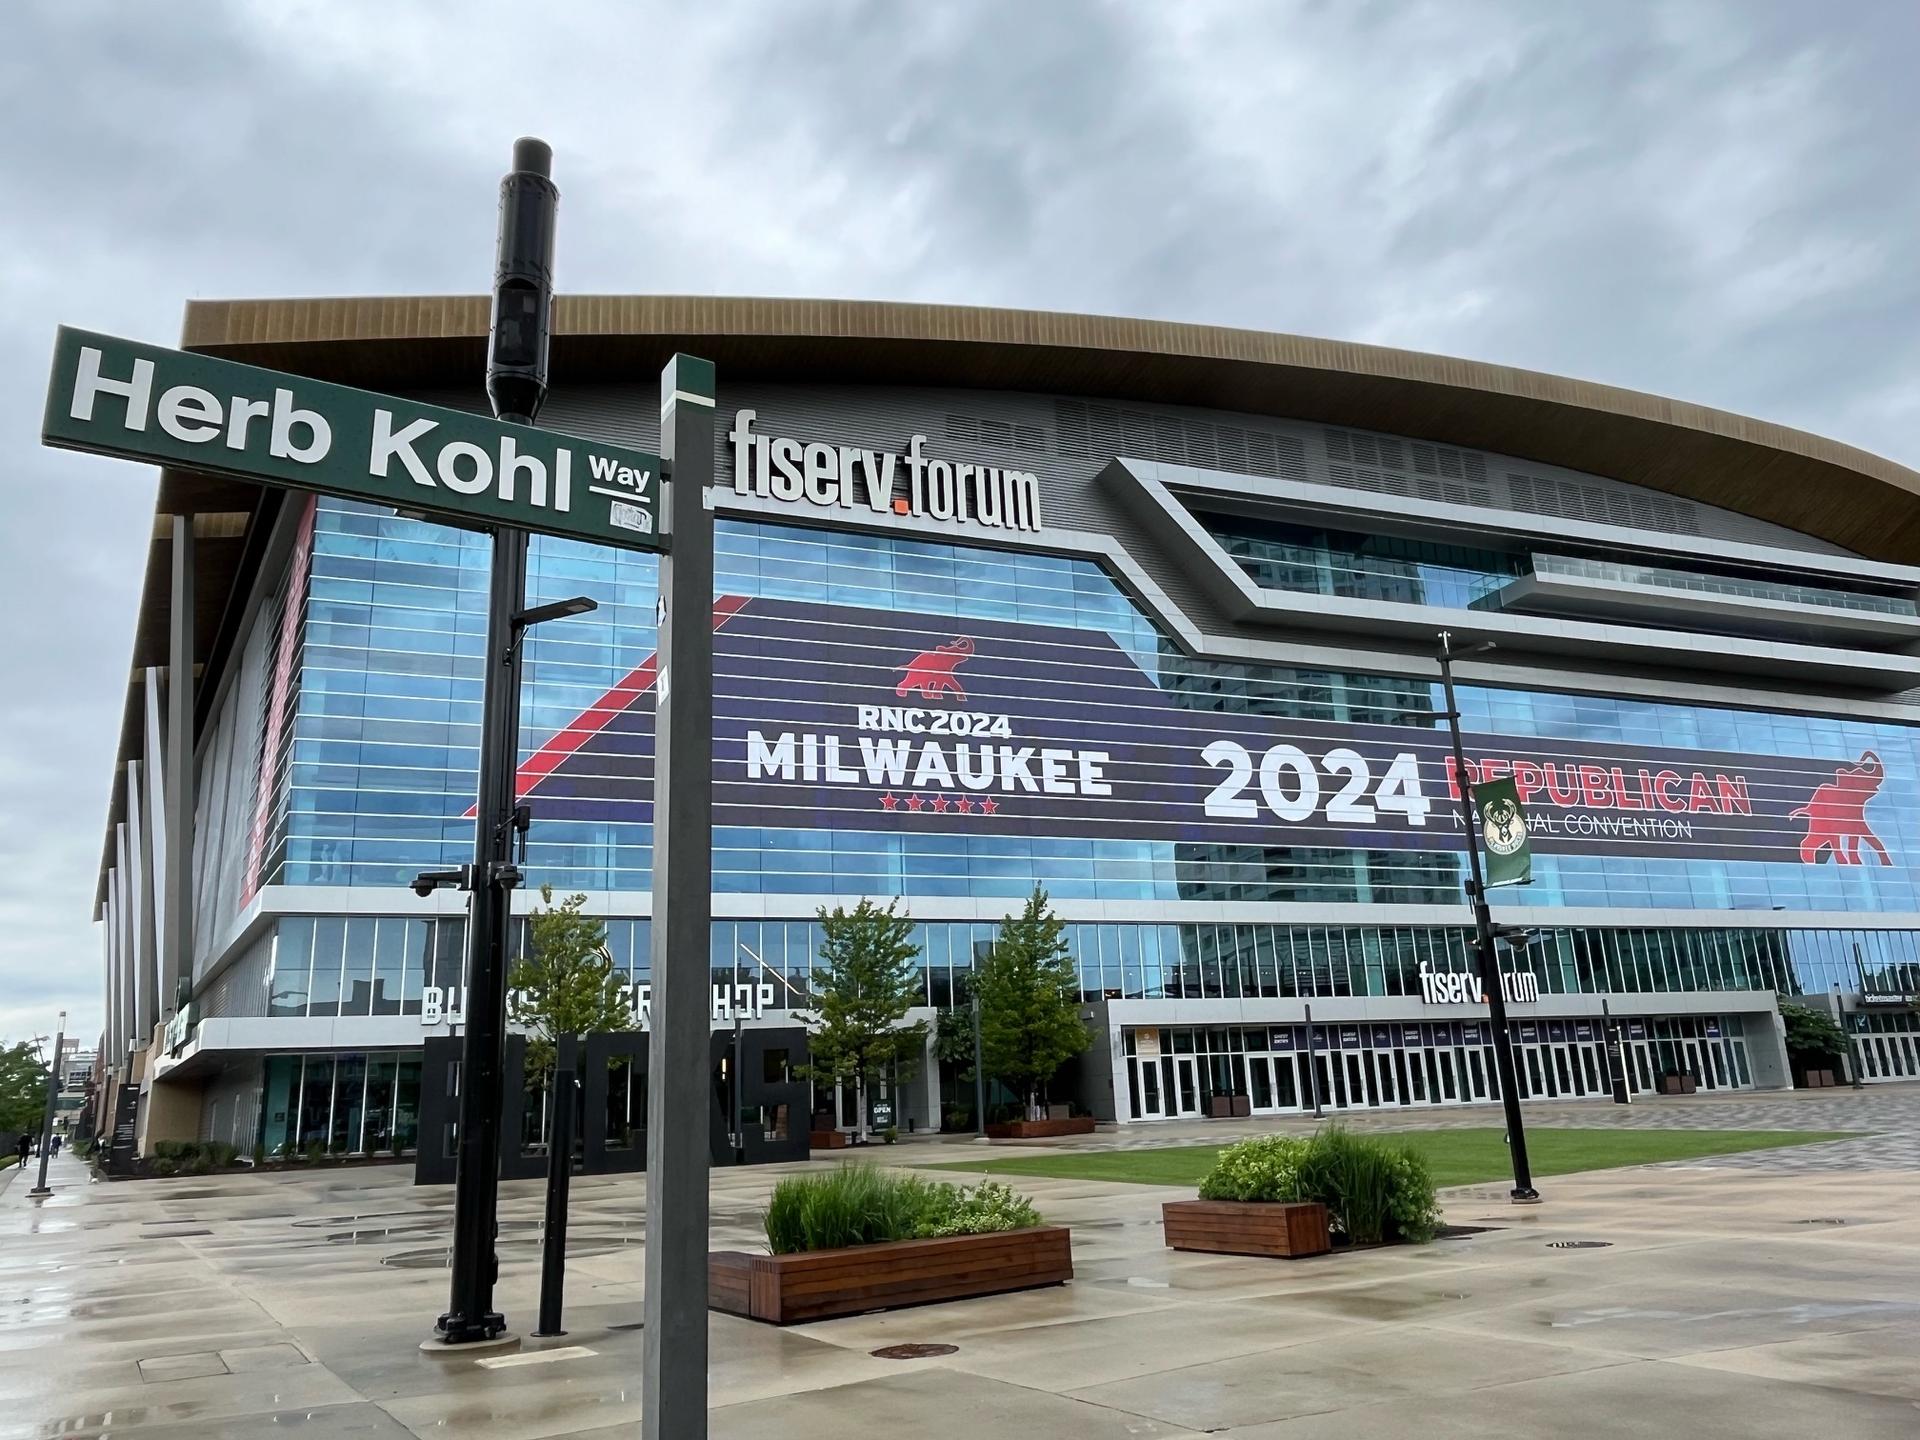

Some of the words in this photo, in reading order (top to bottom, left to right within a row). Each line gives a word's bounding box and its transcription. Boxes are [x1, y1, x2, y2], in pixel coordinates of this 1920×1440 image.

[70, 346, 332, 464] Herb
[369, 409, 571, 512] Kohl
[588, 455, 650, 493] Way
[858, 704, 926, 733] RNC
[930, 710, 1012, 739] 2024
[747, 730, 1113, 796] MILWAUKEE
[1200, 740, 1431, 826] 2024
[1565, 814, 1693, 840] CONVENTION
[711, 984, 774, 1020] HOP
[1420, 961, 1540, 1004] fiserv.rum
